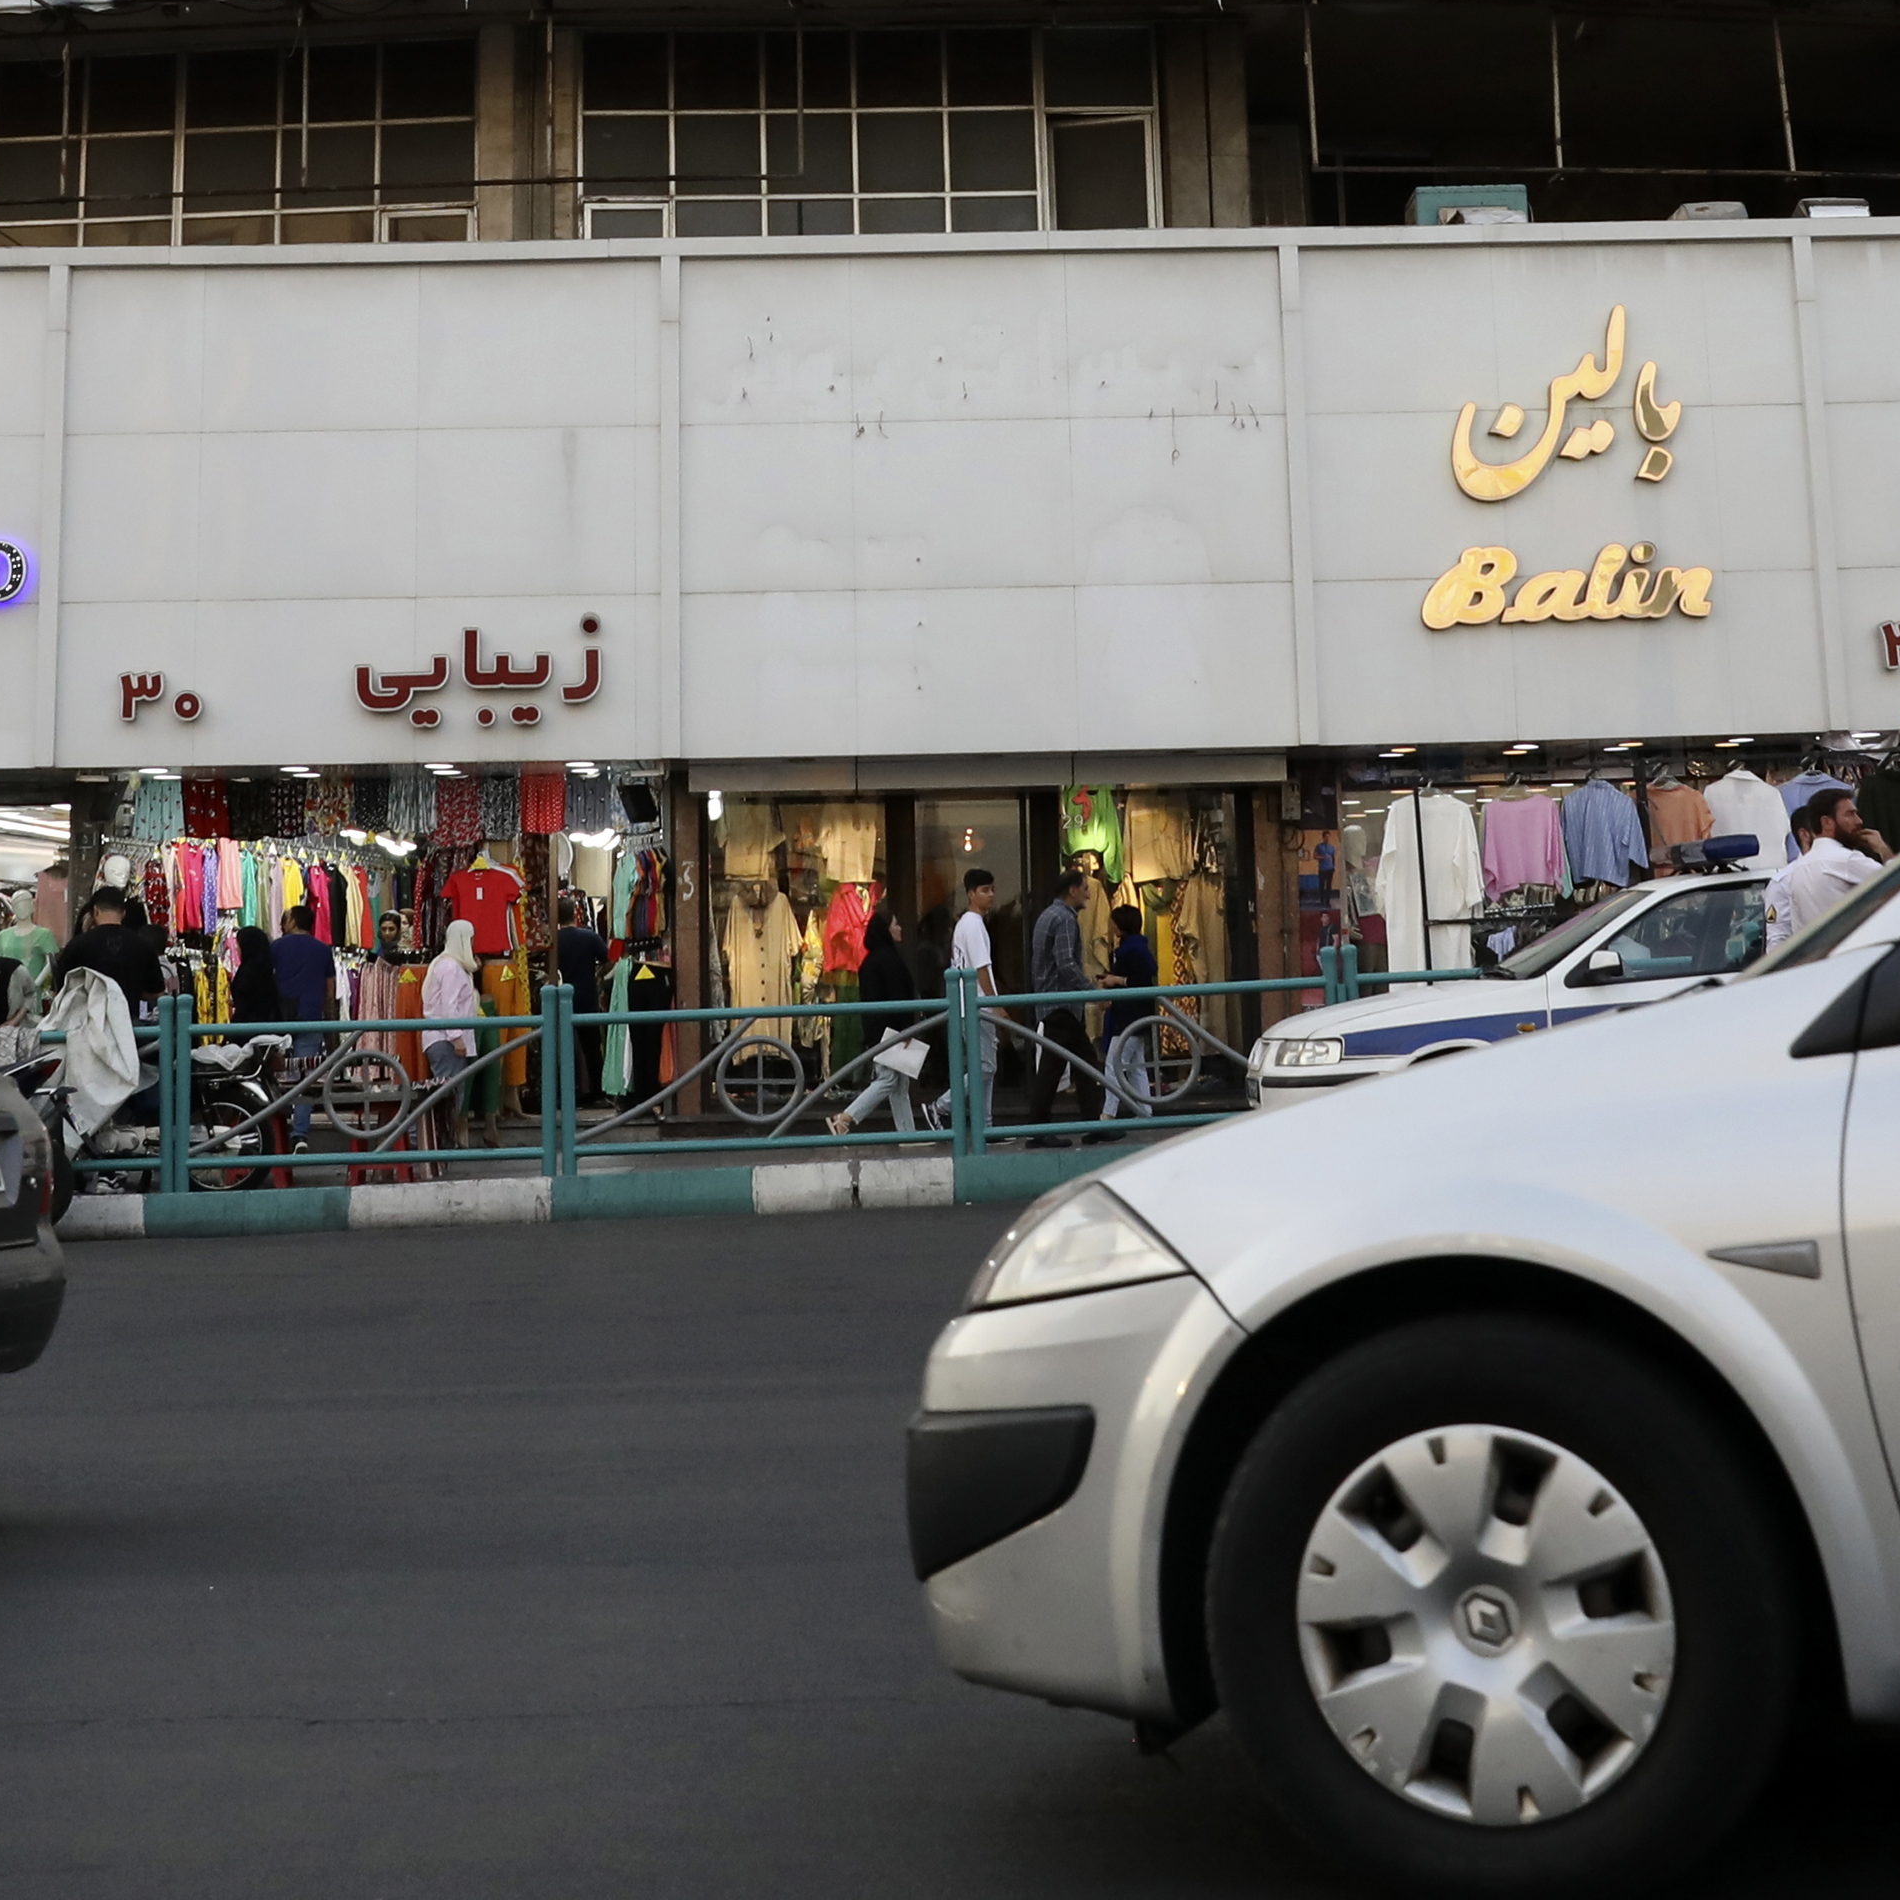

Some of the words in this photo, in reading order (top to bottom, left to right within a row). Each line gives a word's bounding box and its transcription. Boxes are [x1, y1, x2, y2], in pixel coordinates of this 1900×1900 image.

[1451, 303, 1683, 501] بالین
[1421, 541, 1714, 630] Balin
[118, 671, 203, 722] ۳۰
[353, 612, 602, 728] زیبایی
